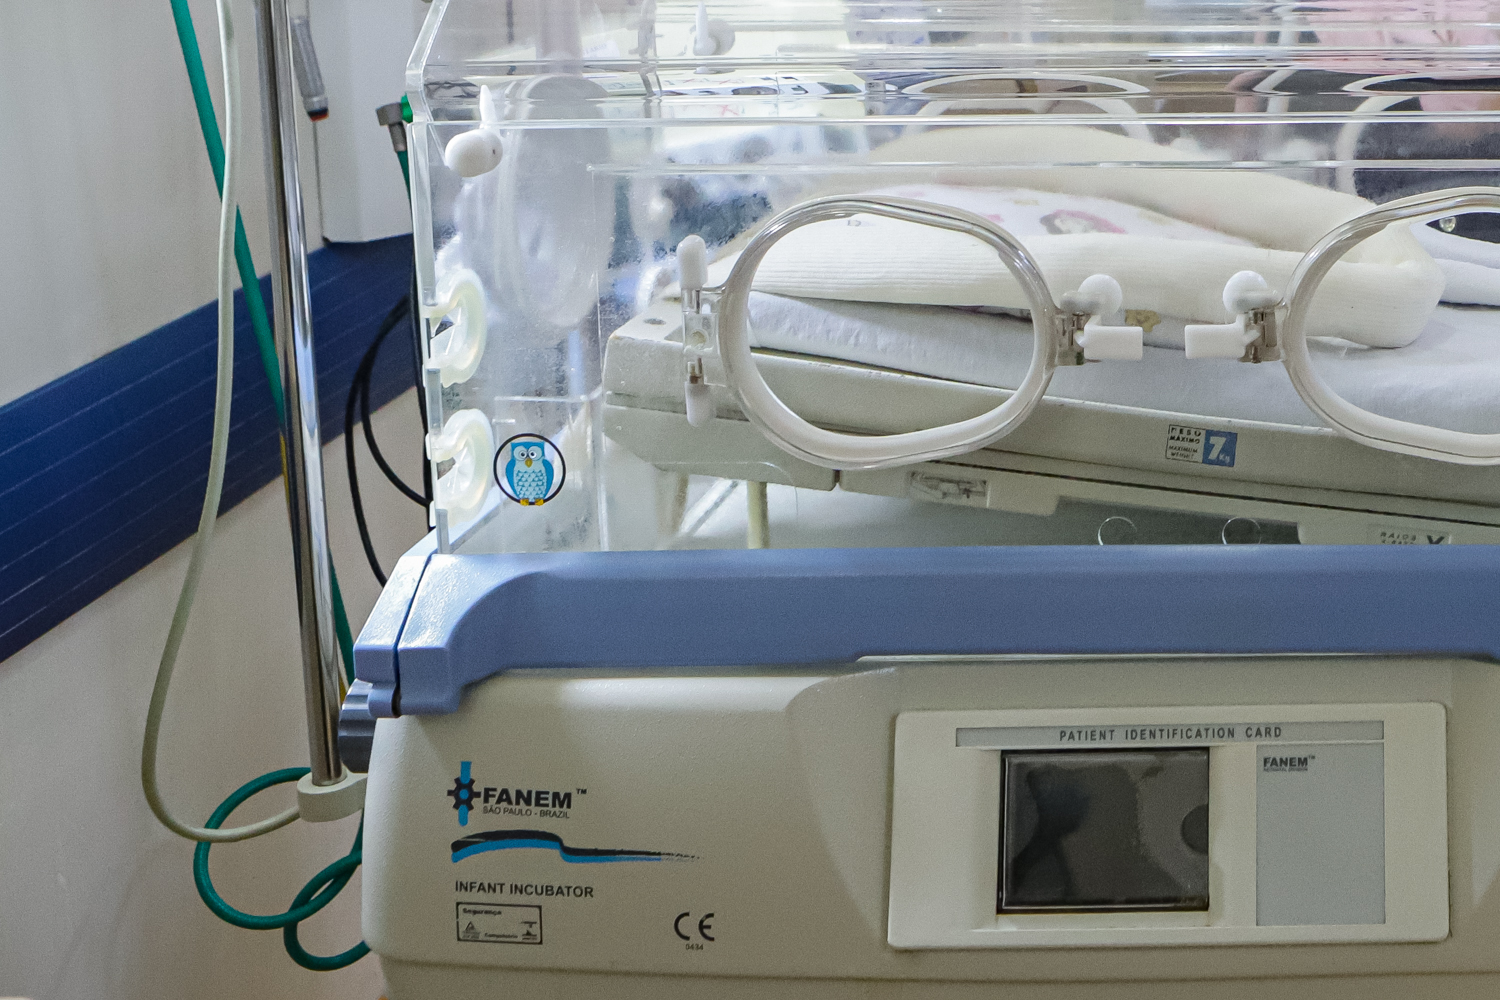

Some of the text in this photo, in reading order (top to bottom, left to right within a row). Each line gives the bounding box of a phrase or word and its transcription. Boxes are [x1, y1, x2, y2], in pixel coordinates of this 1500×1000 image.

[1207, 436, 1227, 460] 7
[1059, 726, 1282, 741] PATIENT IDENTIFICATION CARD
[482, 804, 501, 815] SÃO
[503, 806, 532, 817] PAULO
[539, 809, 570, 819] BRAZIL
[455, 880, 595, 898] INFANT INCUBATOR
